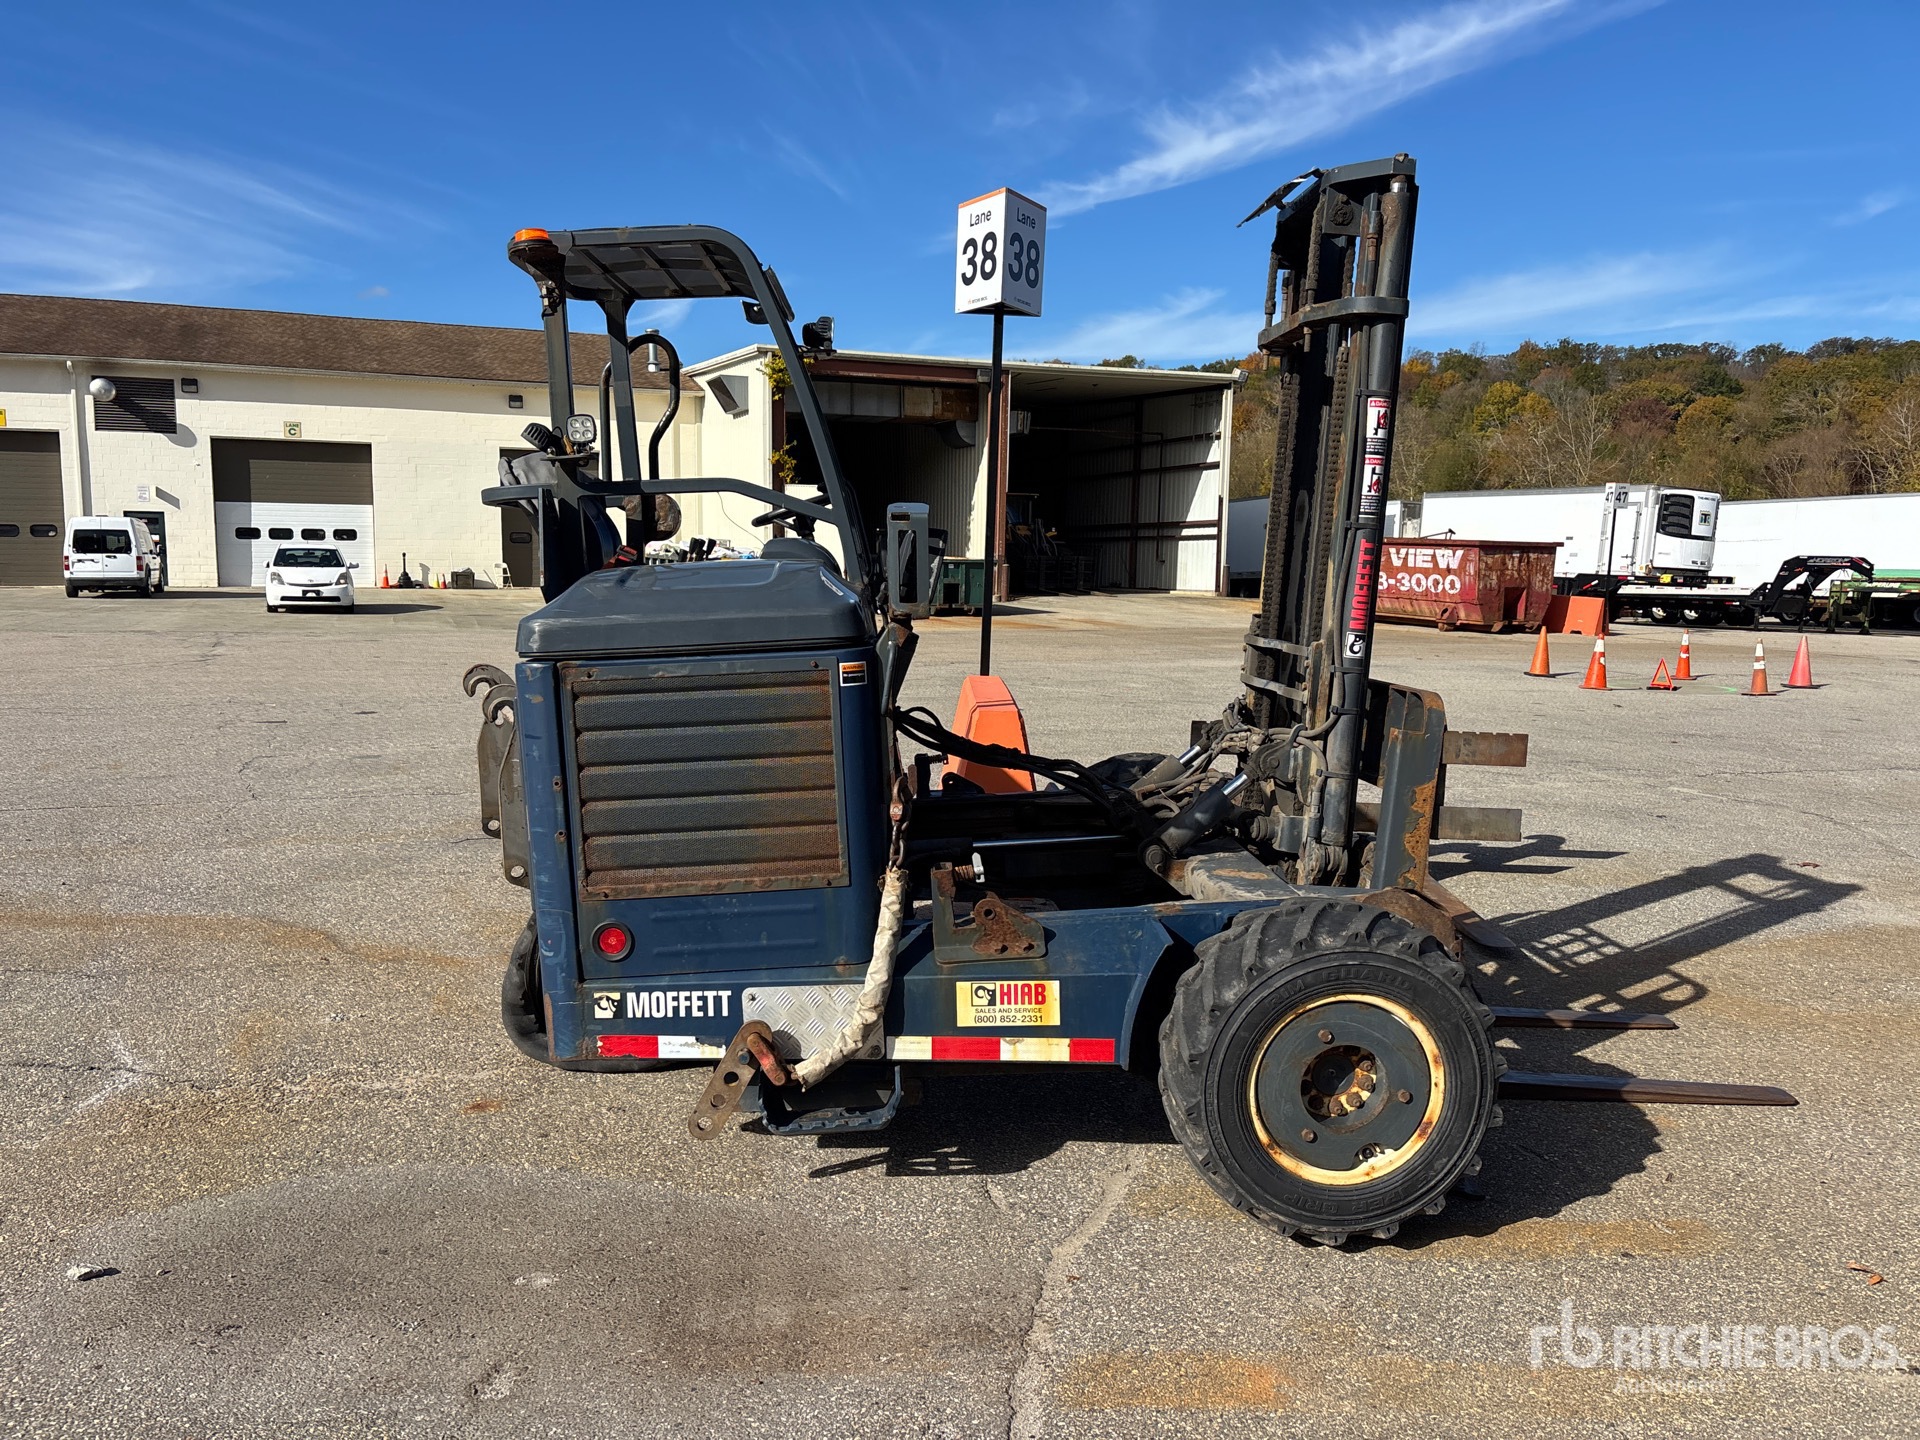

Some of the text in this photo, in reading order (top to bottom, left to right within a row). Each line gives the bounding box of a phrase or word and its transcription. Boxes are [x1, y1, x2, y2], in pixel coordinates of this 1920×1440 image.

[970, 210, 992, 227] Lane
[1016, 207, 1036, 229] Lane
[961, 231, 997, 286] 38
[1008, 232, 1040, 289] 38
[288, 428, 297, 436] C
[1605, 491, 1614, 503] 47
[1615, 491, 1628, 503] 47
[1389, 548, 1464, 569] VIEW
[1349, 539, 1375, 630] MOFFETT
[1322, 967, 1414, 991] GUARD
[627, 990, 732, 1019] MOFFETT
[1000, 983, 1047, 1006] HIAB
[974, 1014, 1043, 1024] (800) 852-2331
